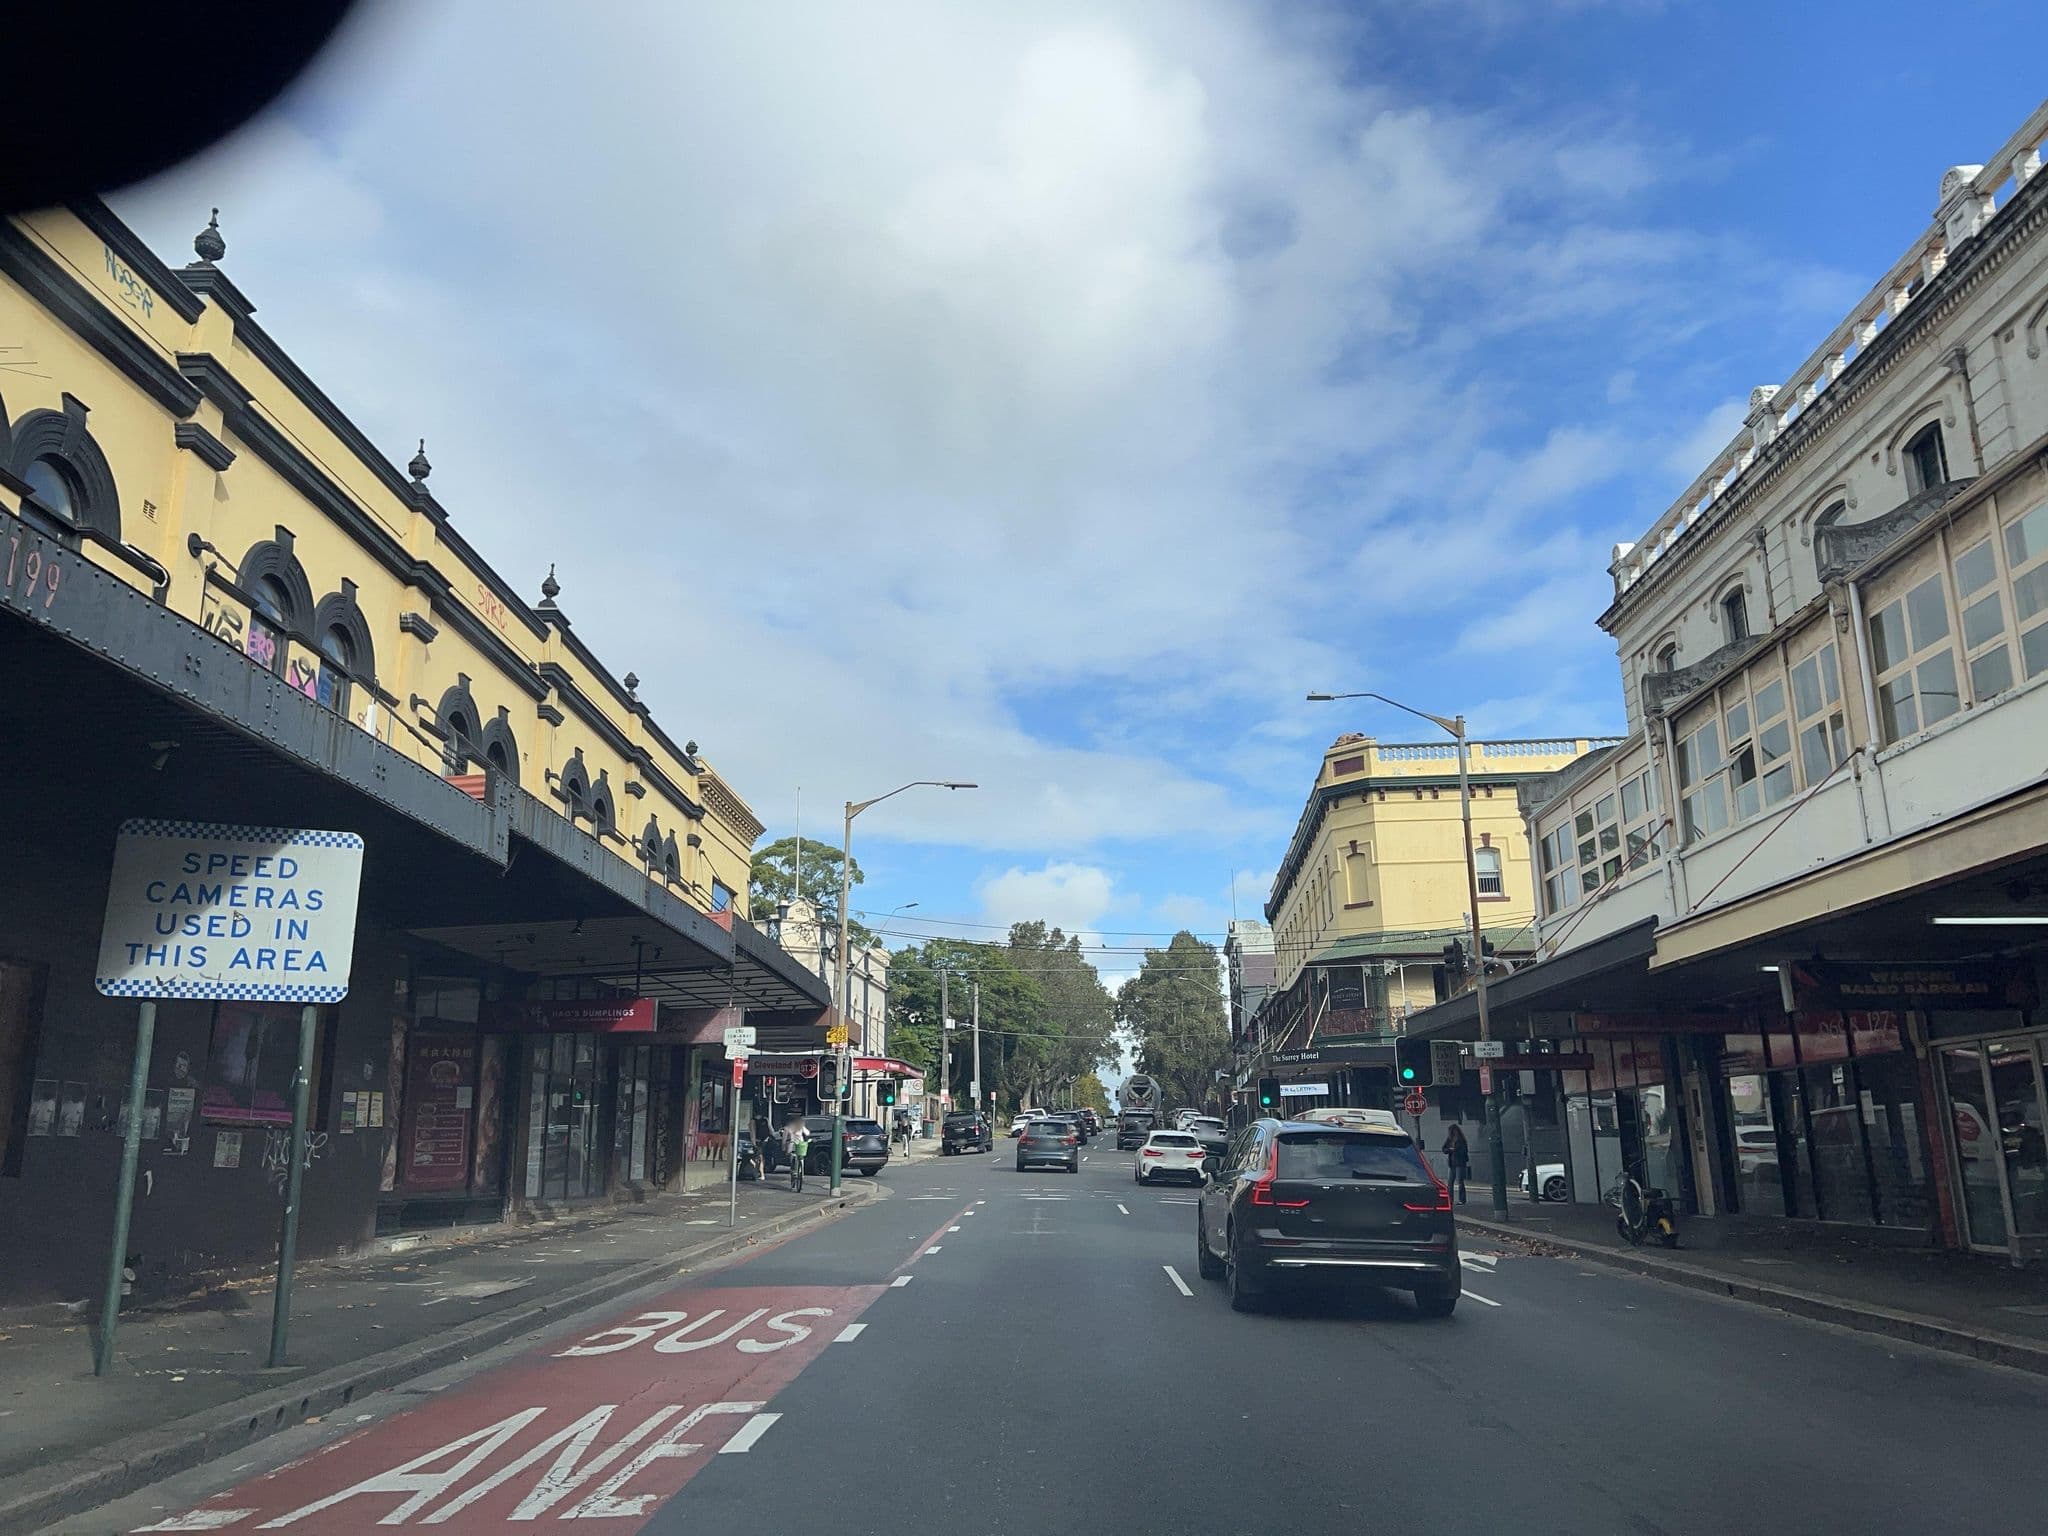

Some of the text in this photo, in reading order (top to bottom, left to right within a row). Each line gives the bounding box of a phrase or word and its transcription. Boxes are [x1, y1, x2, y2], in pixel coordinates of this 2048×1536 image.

[7, 536, 60, 608] 199
[182, 853, 298, 879] SPEED
[146, 881, 324, 911] CAMERAS
[155, 912, 309, 941] USED IN
[125, 943, 328, 972] THIS AREA
[582, 1008, 635, 1017] DUMPLINGS
[754, 1061, 792, 1069] Cleveland
[801, 1063, 817, 1073] STOP
[1300, 1051, 1319, 1060] Hotel
[1406, 1100, 1425, 1109] STOP
[551, 1308, 834, 1358] BUS
